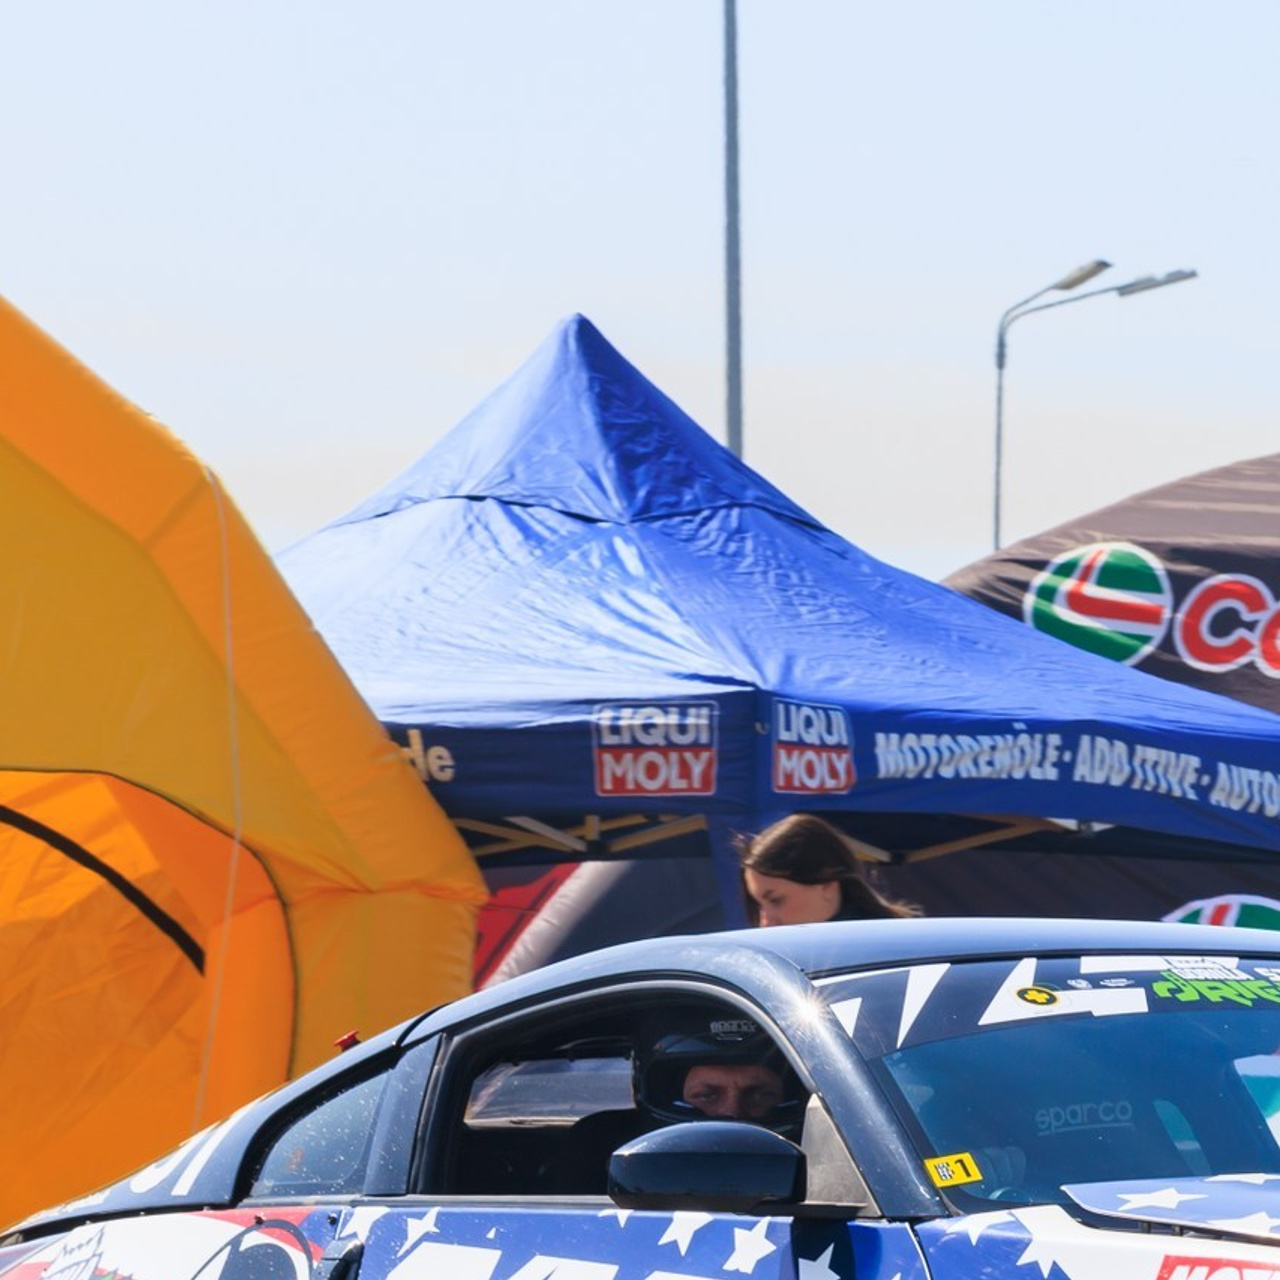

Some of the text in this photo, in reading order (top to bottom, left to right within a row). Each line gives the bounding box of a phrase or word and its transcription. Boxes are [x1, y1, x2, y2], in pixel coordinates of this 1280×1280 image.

[600, 706, 711, 746] LIQUI
[777, 703, 848, 746] LIQUI
[602, 752, 711, 790] MOLY
[778, 749, 850, 788] MOLY
[1035, 1101, 1133, 1135] sparco
